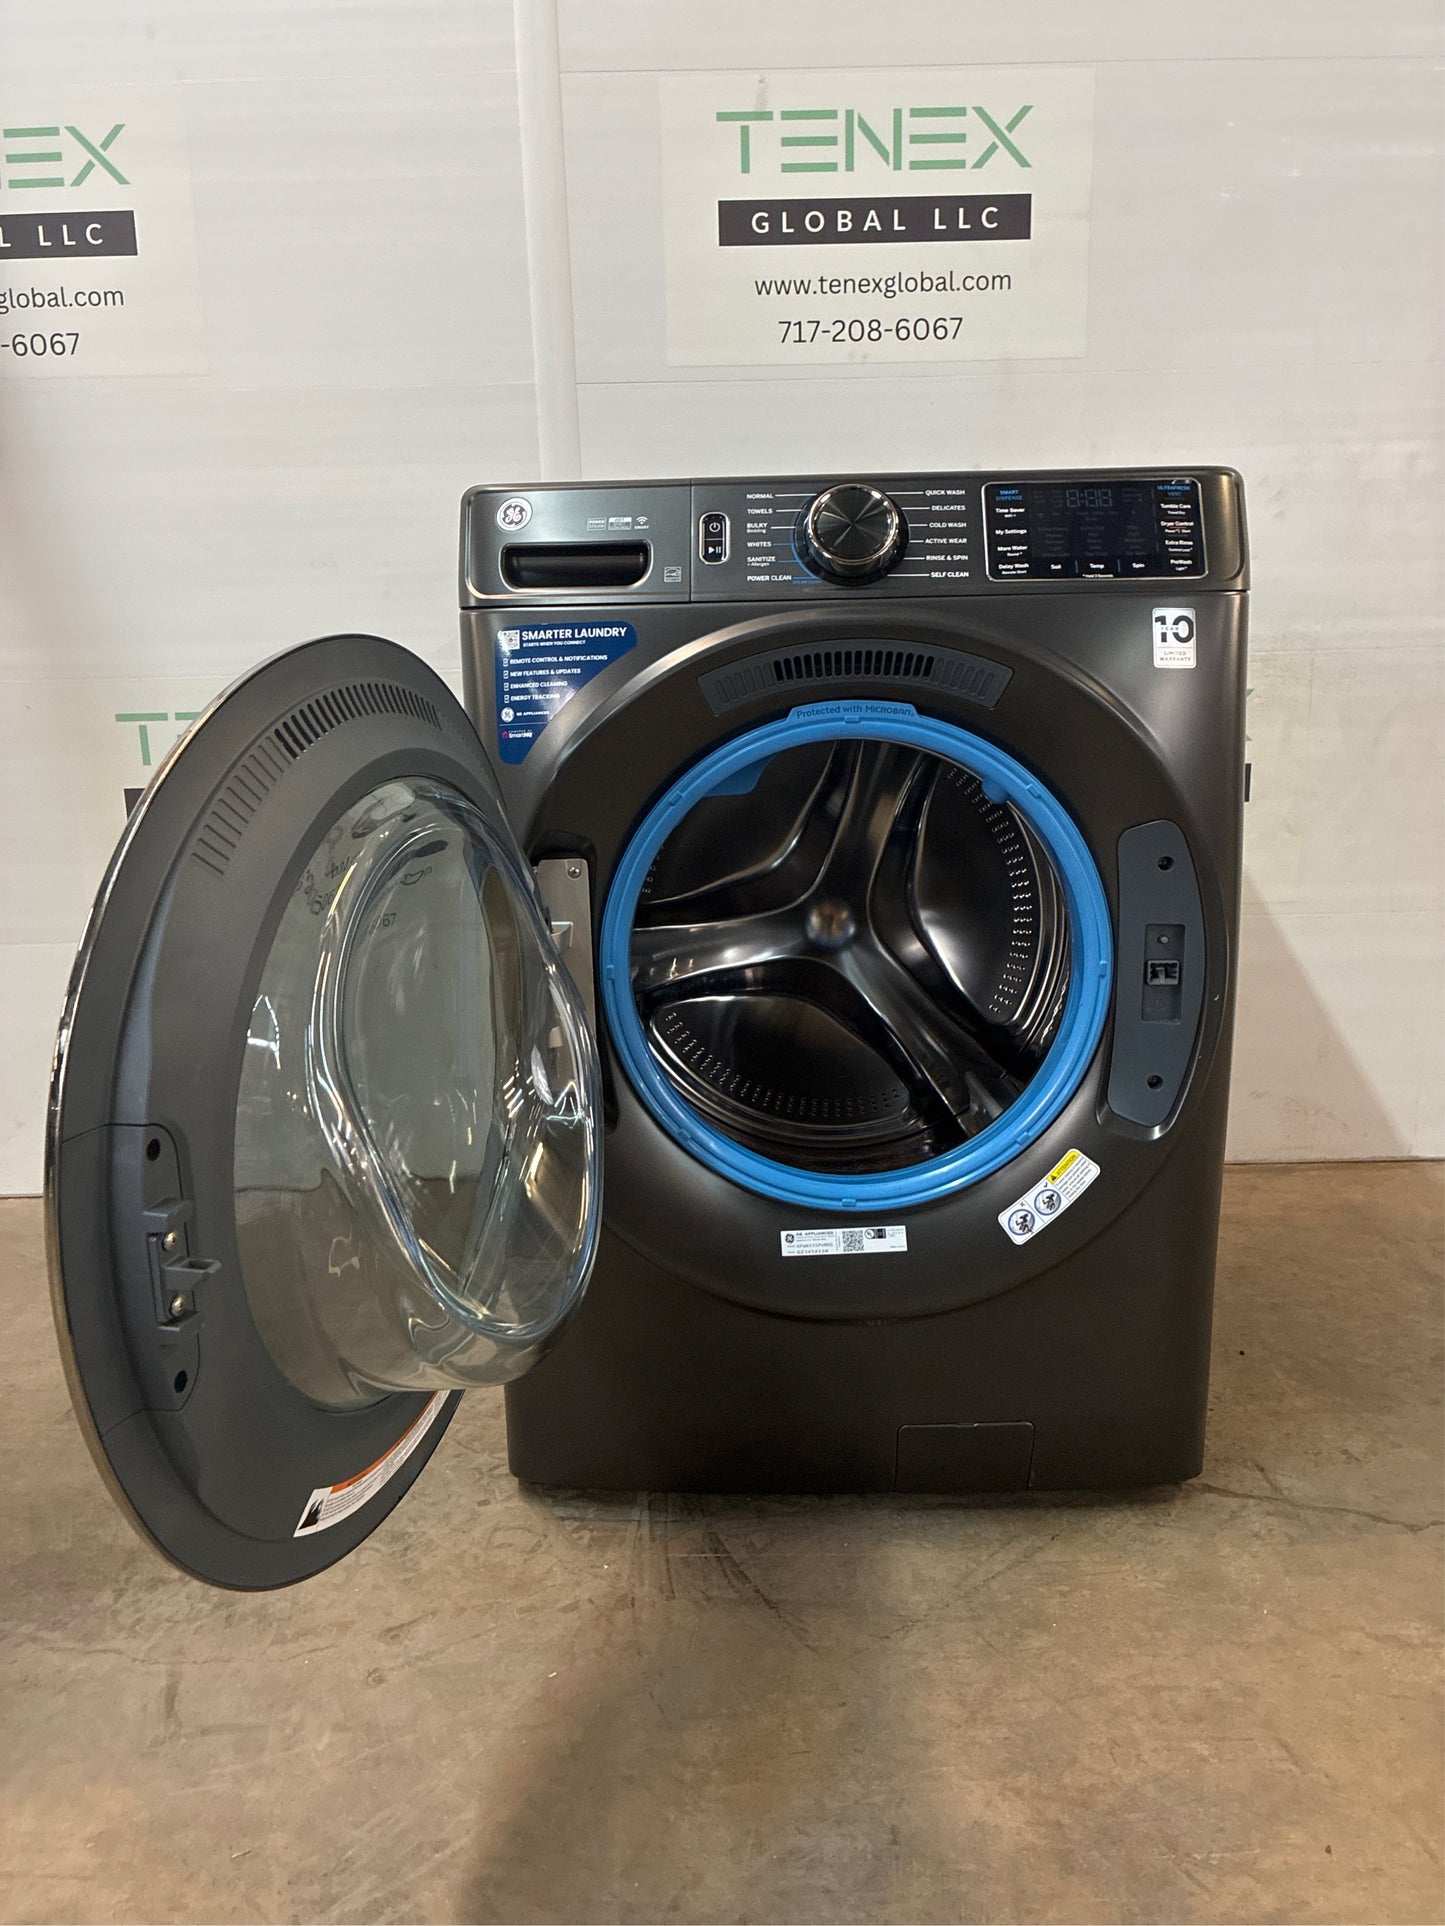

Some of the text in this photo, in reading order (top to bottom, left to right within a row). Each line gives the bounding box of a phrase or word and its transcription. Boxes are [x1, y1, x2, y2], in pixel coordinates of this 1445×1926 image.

[716, 105, 1033, 174] TENEX
[751, 206, 1000, 234] GLOBAL LLC
[37, 223, 104, 247] LLC
[754, 271, 1012, 298] www.tenexglobal.com
[778, 317, 964, 344] 717-208-6067
[522, 627, 627, 640] SMARTER LAUNDRY
[1155, 615, 1194, 643] 10
[797, 705, 840, 719] Protected
[843, 705, 862, 713] with
